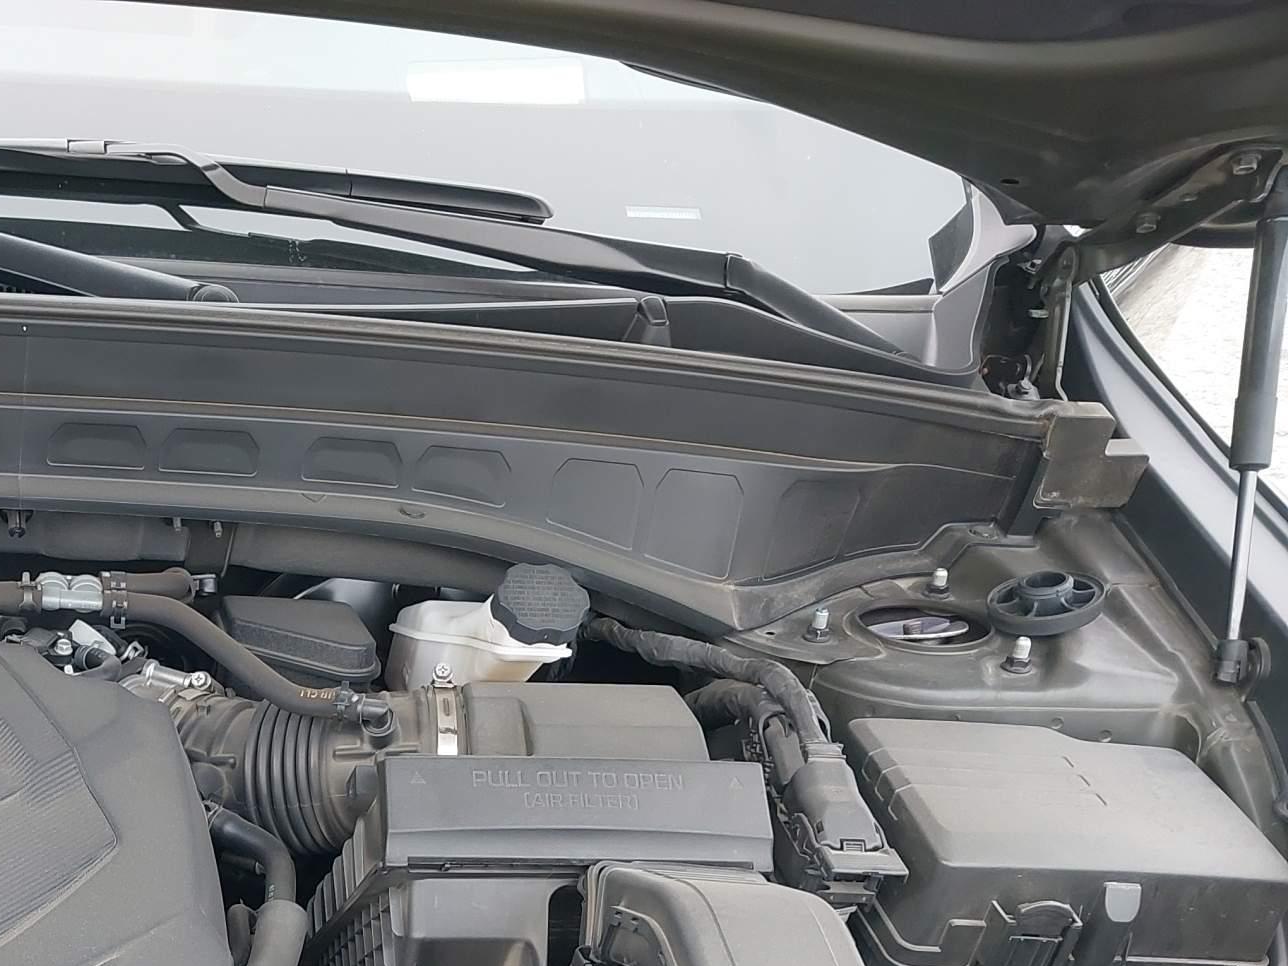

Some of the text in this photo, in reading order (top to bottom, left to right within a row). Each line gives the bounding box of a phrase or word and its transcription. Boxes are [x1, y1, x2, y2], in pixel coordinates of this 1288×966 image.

[472, 770, 683, 791] PULL OUT TO OPEN
